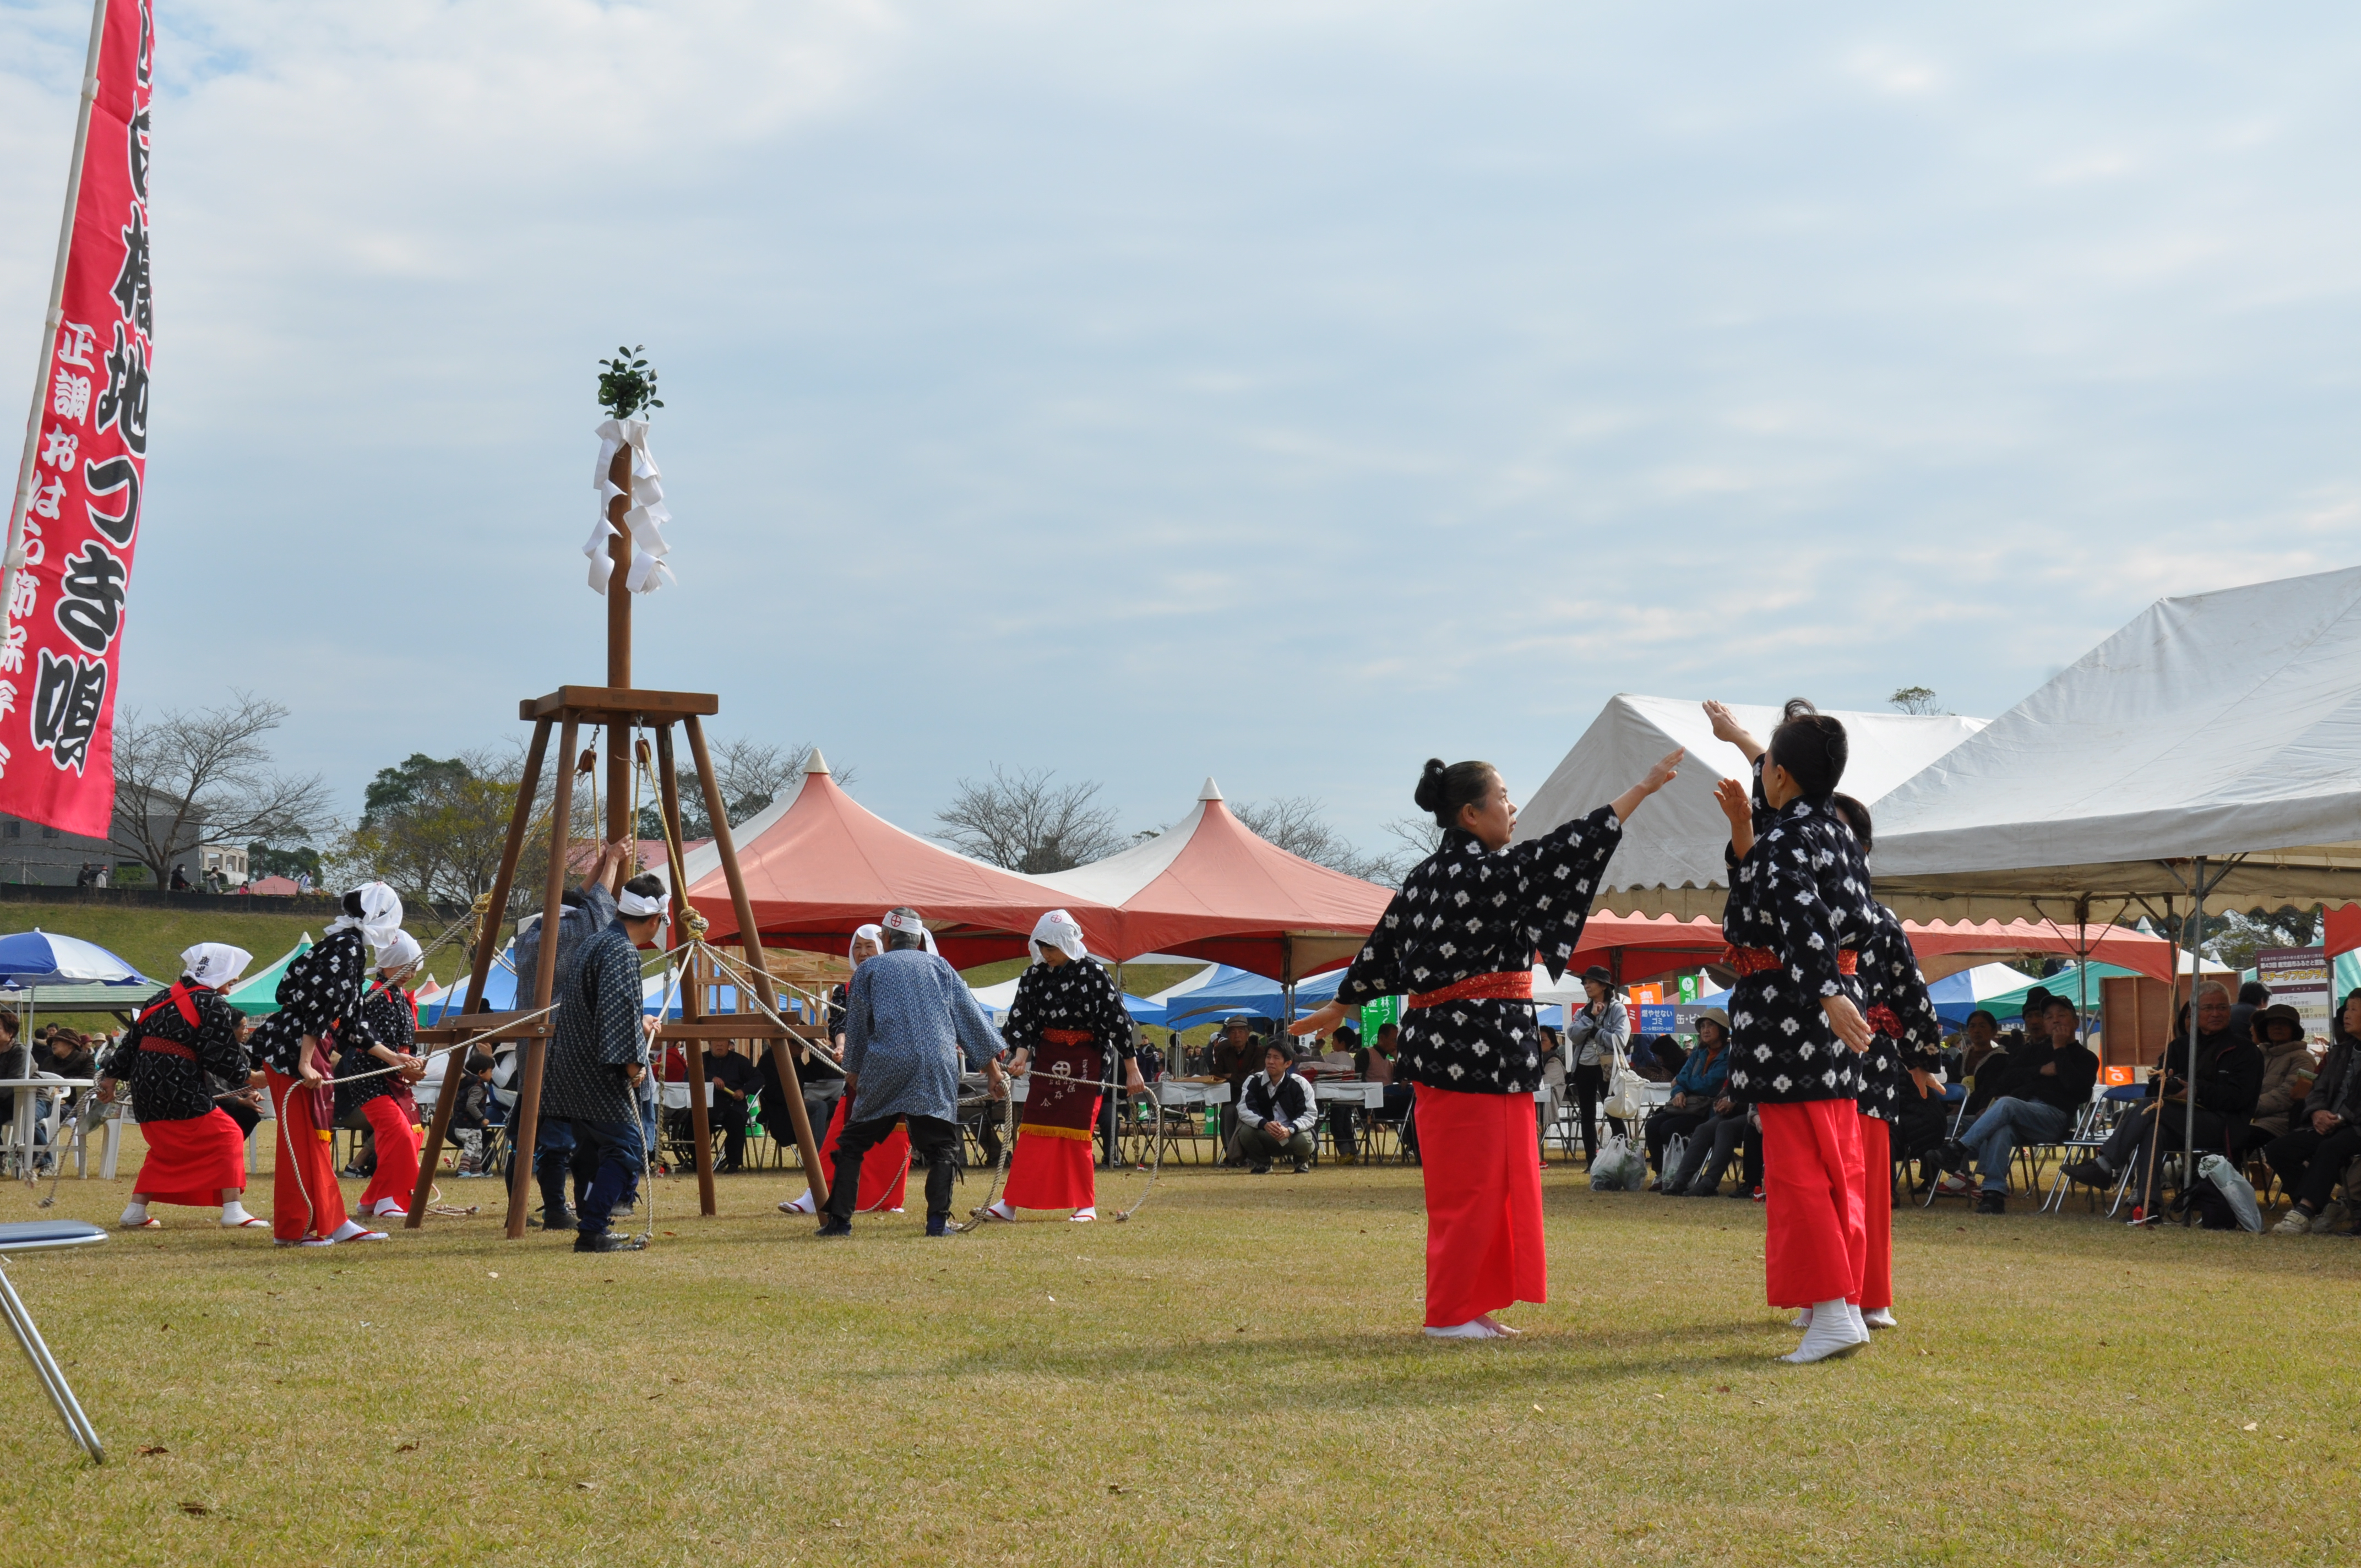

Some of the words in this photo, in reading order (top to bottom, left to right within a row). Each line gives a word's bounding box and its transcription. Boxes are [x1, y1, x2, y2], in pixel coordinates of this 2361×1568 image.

[1641, 1009, 1673, 1017] 燃やせない
